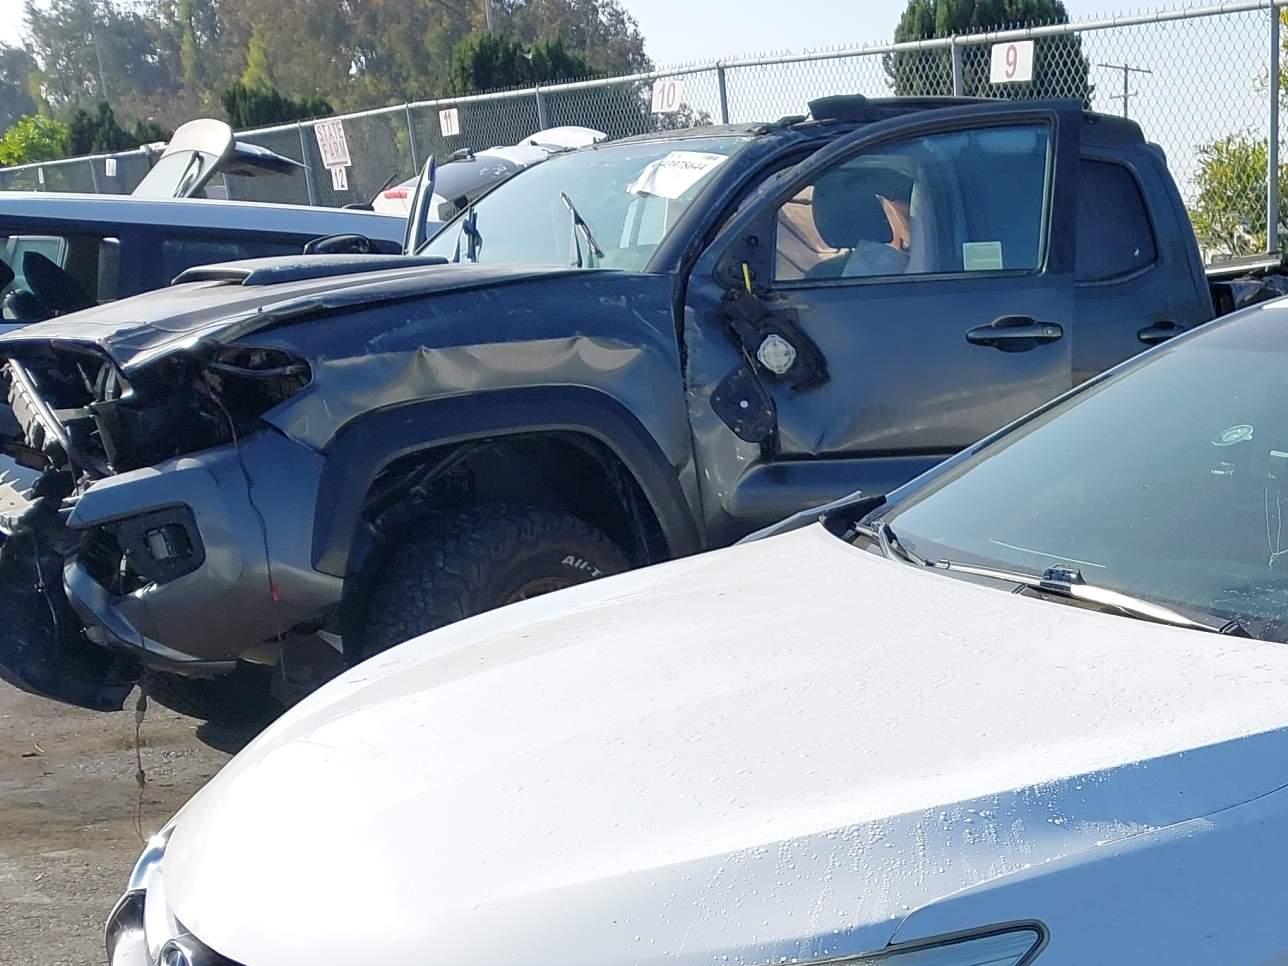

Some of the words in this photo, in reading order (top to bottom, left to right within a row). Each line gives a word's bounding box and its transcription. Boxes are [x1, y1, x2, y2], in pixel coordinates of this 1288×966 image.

[1005, 44, 1018, 79] 9
[659, 82, 676, 110] 10
[316, 121, 344, 142] STATE
[443, 110, 453, 134] 11
[321, 139, 349, 162] FARM
[333, 168, 346, 189] 12
